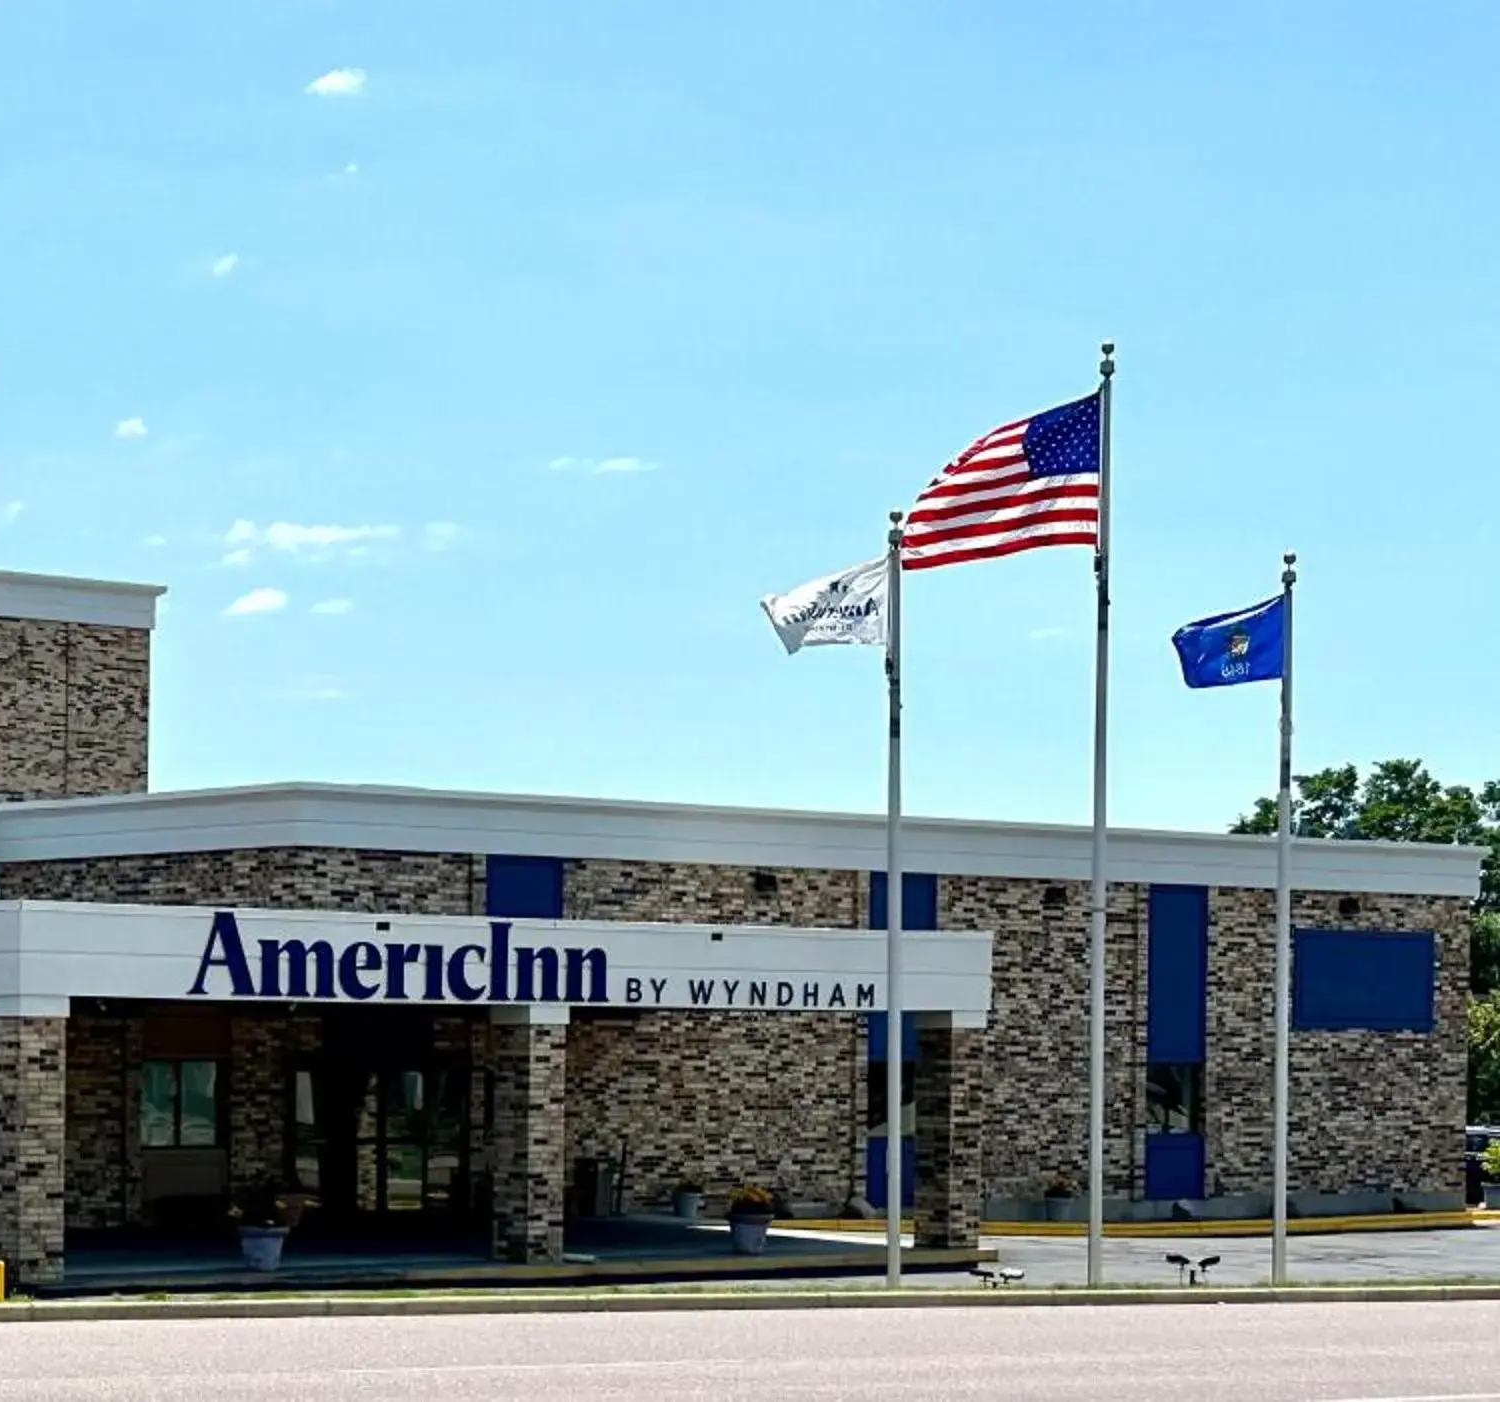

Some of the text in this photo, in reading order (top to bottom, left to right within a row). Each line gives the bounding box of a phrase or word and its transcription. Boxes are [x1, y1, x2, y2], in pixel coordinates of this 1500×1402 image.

[186, 911, 876, 1008] AmericInn BY WYNDHAM
